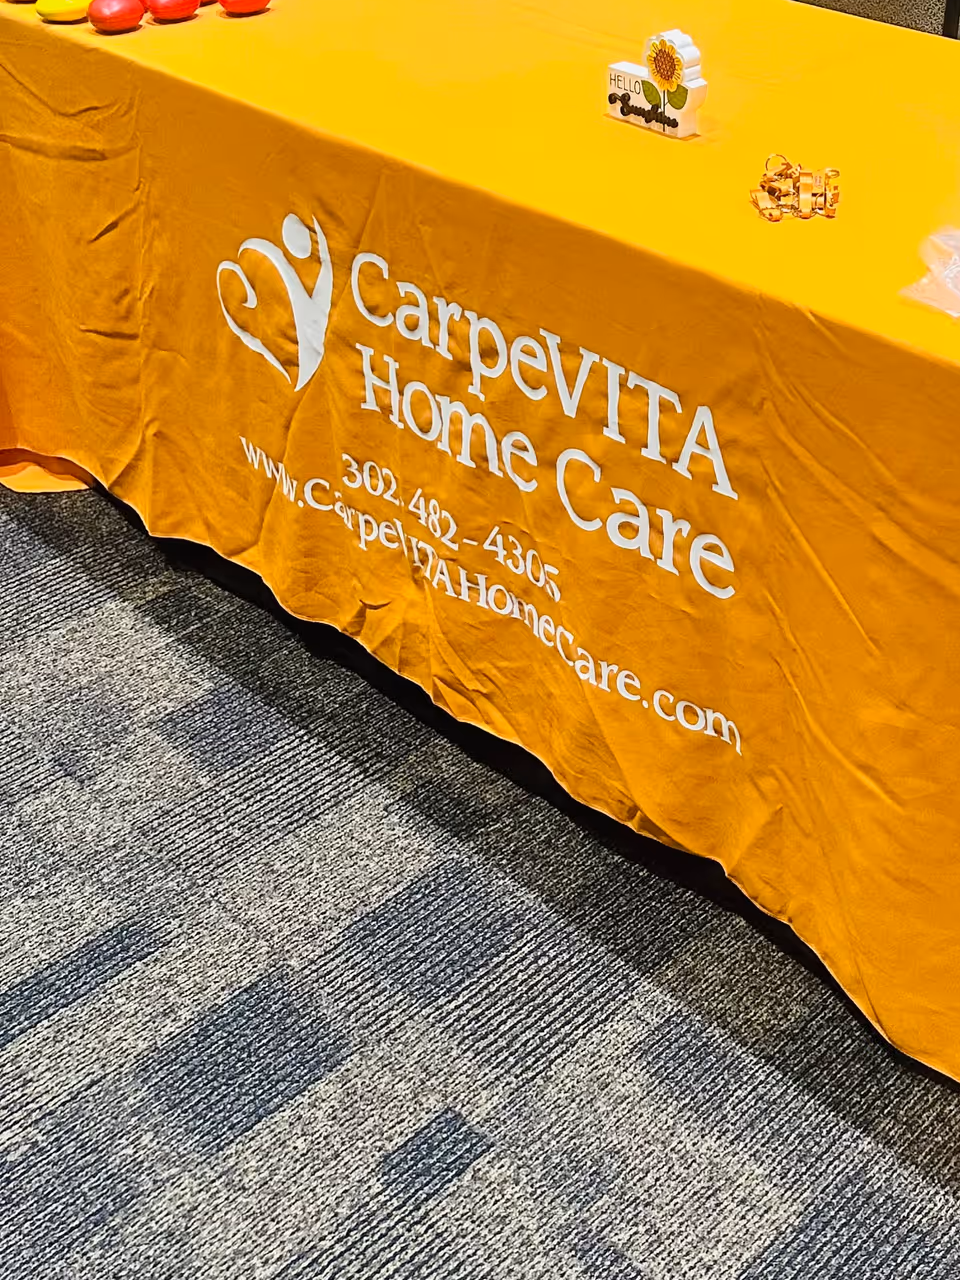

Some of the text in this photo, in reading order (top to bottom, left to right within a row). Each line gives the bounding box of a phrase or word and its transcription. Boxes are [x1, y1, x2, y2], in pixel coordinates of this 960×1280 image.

[609, 73, 641, 94] HELLO
[351, 252, 738, 500] CarpeVITA
[355, 342, 736, 599] Home Care
[342, 453, 561, 602] 302482-4305
